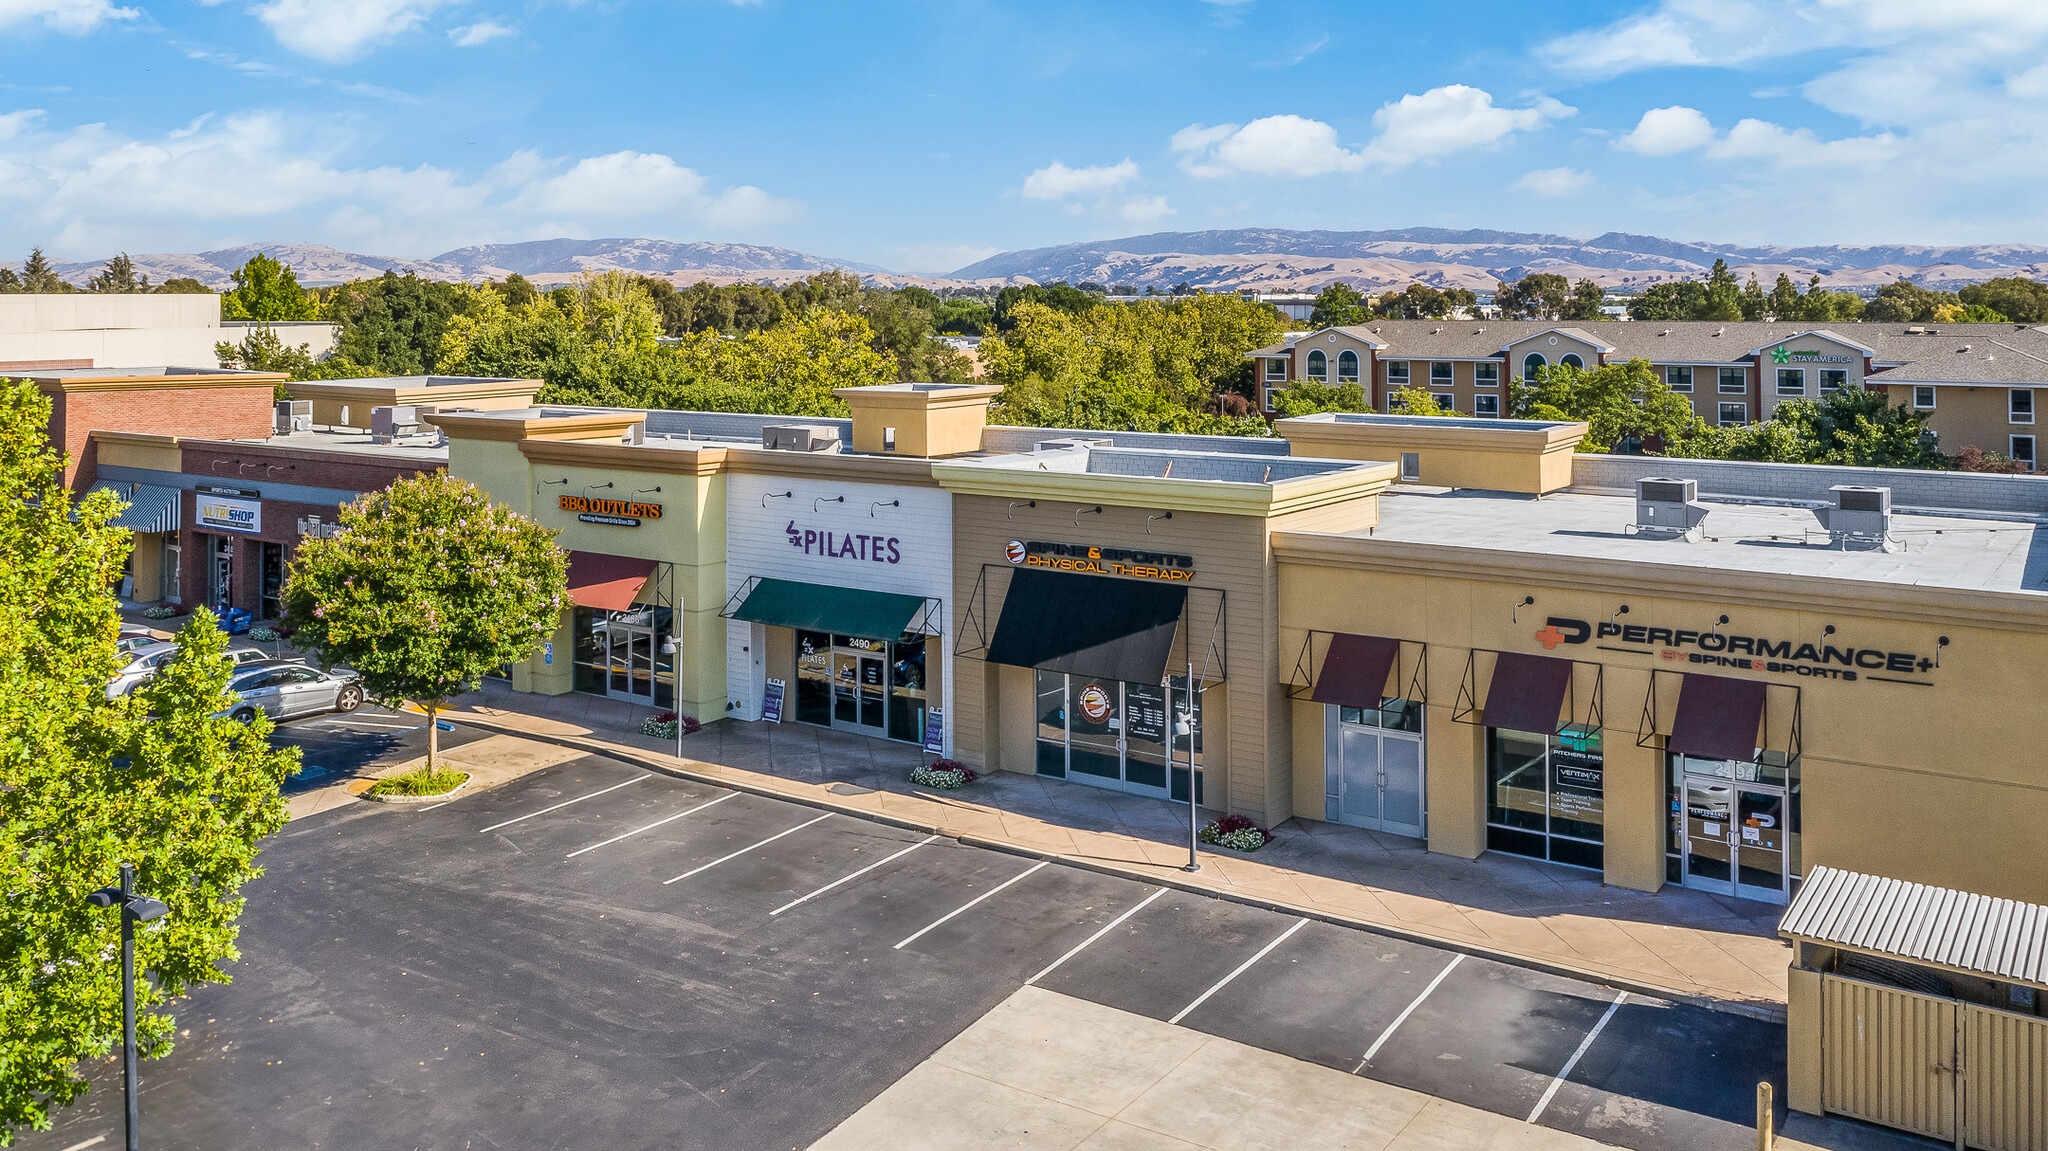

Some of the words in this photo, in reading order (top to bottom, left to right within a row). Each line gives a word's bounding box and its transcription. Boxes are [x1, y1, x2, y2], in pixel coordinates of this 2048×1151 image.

[558, 495, 589, 512] BBQ
[590, 498, 661, 519] OUTLETS
[804, 530, 900, 564] PILATES
[1027, 555, 1109, 574] PHYSICAL
[1110, 563, 1195, 582] THERAPY
[849, 638, 870, 649] 2490
[801, 653, 826, 665] PILATES
[1553, 749, 1586, 759] PITCHERS
[1560, 807, 1579, 815] Training
